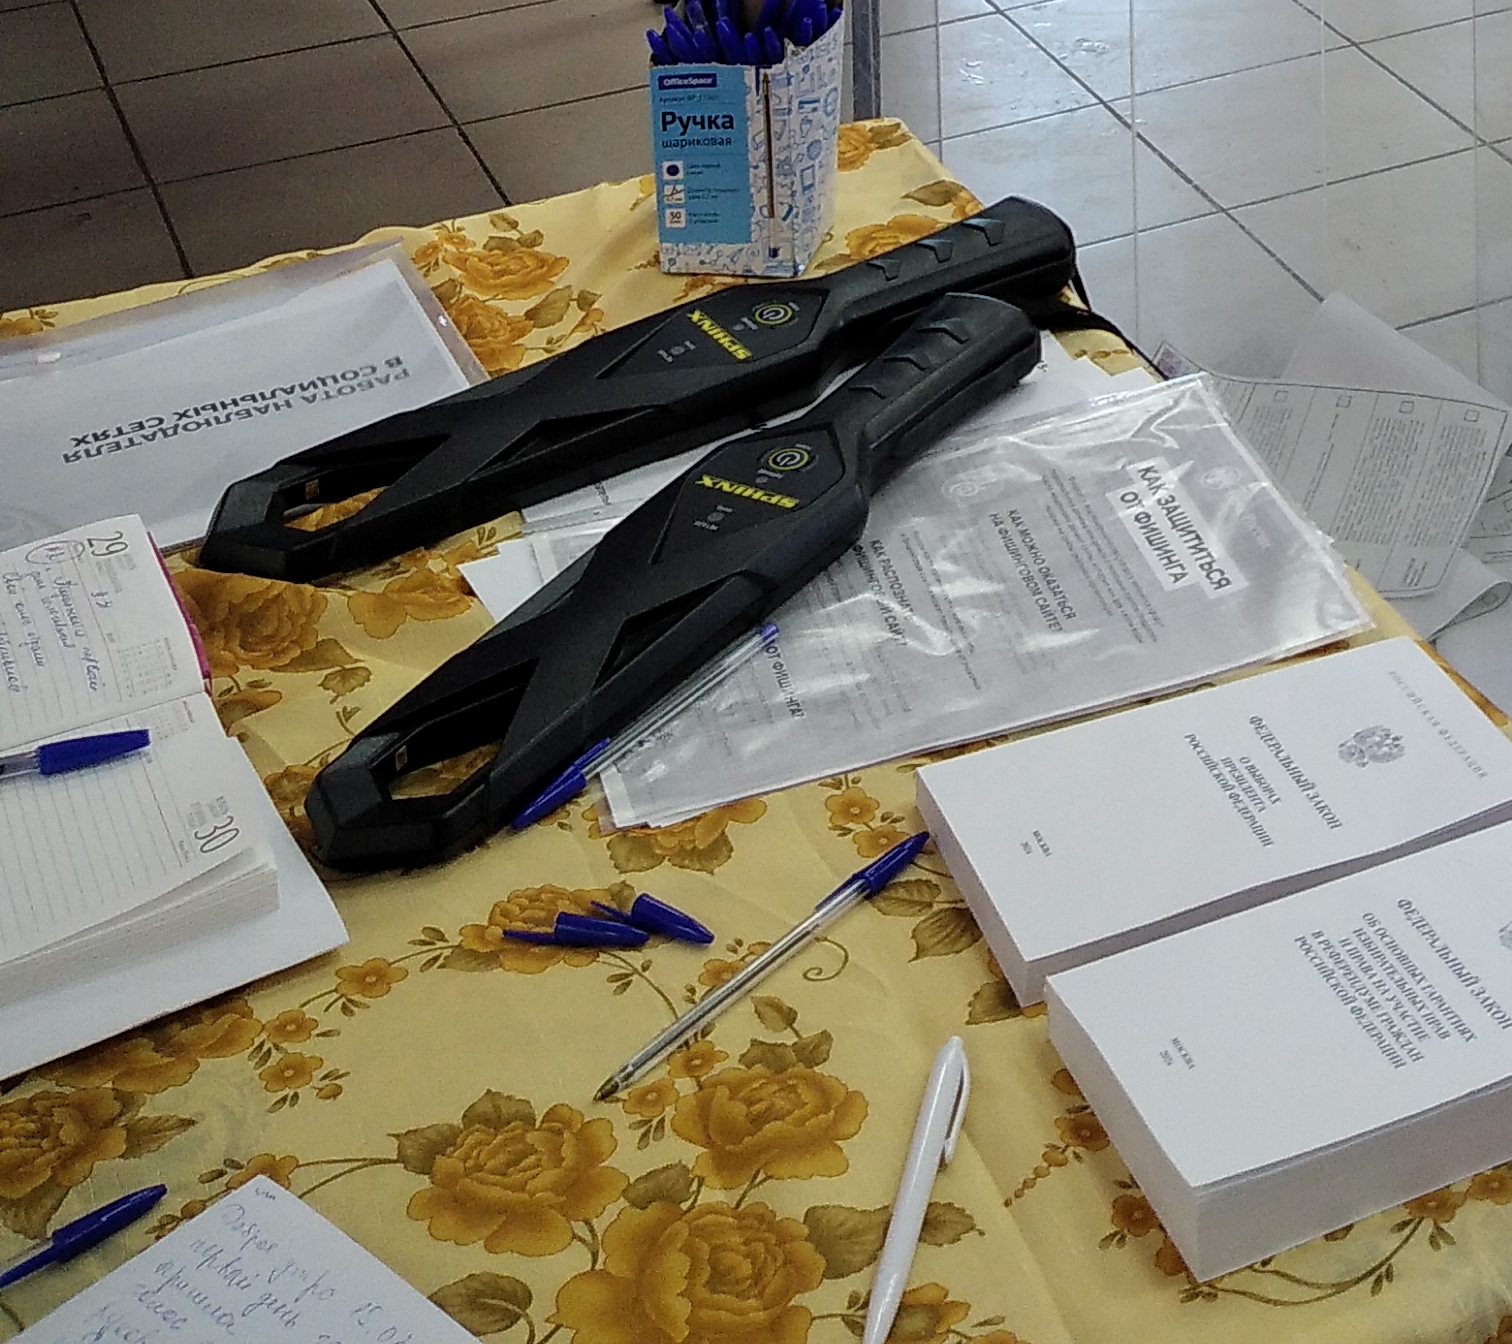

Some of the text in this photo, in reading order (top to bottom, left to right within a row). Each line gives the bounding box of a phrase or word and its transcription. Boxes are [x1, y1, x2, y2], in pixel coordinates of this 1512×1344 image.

[663, 76, 713, 88] OfficeSpace
[661, 111, 735, 137] Ручка
[661, 136, 733, 149] шариковая
[687, 309, 753, 361] SPHINX
[60, 366, 410, 465] РАБОТА НАБЛЮДАТЕЛЯ
[172, 361, 378, 422] СОЦИАЛЬНЫХ
[69, 413, 166, 448] СЕТЯХ
[695, 474, 800, 509] SPHINX
[86, 529, 129, 558] 29
[870, 538, 887, 556] КАК
[1131, 510, 1189, 582] ФИШИНГА
[1136, 465, 1232, 589] КАК ЗАЩИТИТЬСЯ
[1016, 527, 1046, 565] МОЖНО
[1037, 564, 1077, 620] ОКАЗАТЬСЯ
[1183, 733, 1274, 849] РОССИЙСКОЙ ФЕДЕРАЦИИ
[1219, 755, 1268, 812] ПРЕЗИДЕНТА
[1243, 764, 1282, 806] ВЫБОРАХ
[1246, 714, 1343, 830] ФЕДЕРАЛЬНЫЙ ЗАКОН
[194, 814, 240, 854] 30
[1360, 912, 1477, 1042] ОБ ОСНОВНЫХ ГАРАНТИЯХ
[1394, 897, 1482, 991] ФЕДЕРАЛЬНЫЙ
[1292, 935, 1408, 1069] РОССИЙСКОЙ ФЕДЕРАЦИИ
[1315, 938, 1384, 1010] РЕФЕРЕНДУМЕ
[1374, 1011, 1425, 1062] ГРАЖДАН
[1344, 947, 1379, 978] ПРАВА
[1371, 979, 1392, 994] НА
[1384, 995, 1431, 1042] УЧАСТИЕ
[1350, 927, 1452, 1039] ИЗБИРАТЕЛЬНЫХ ПРАВ
